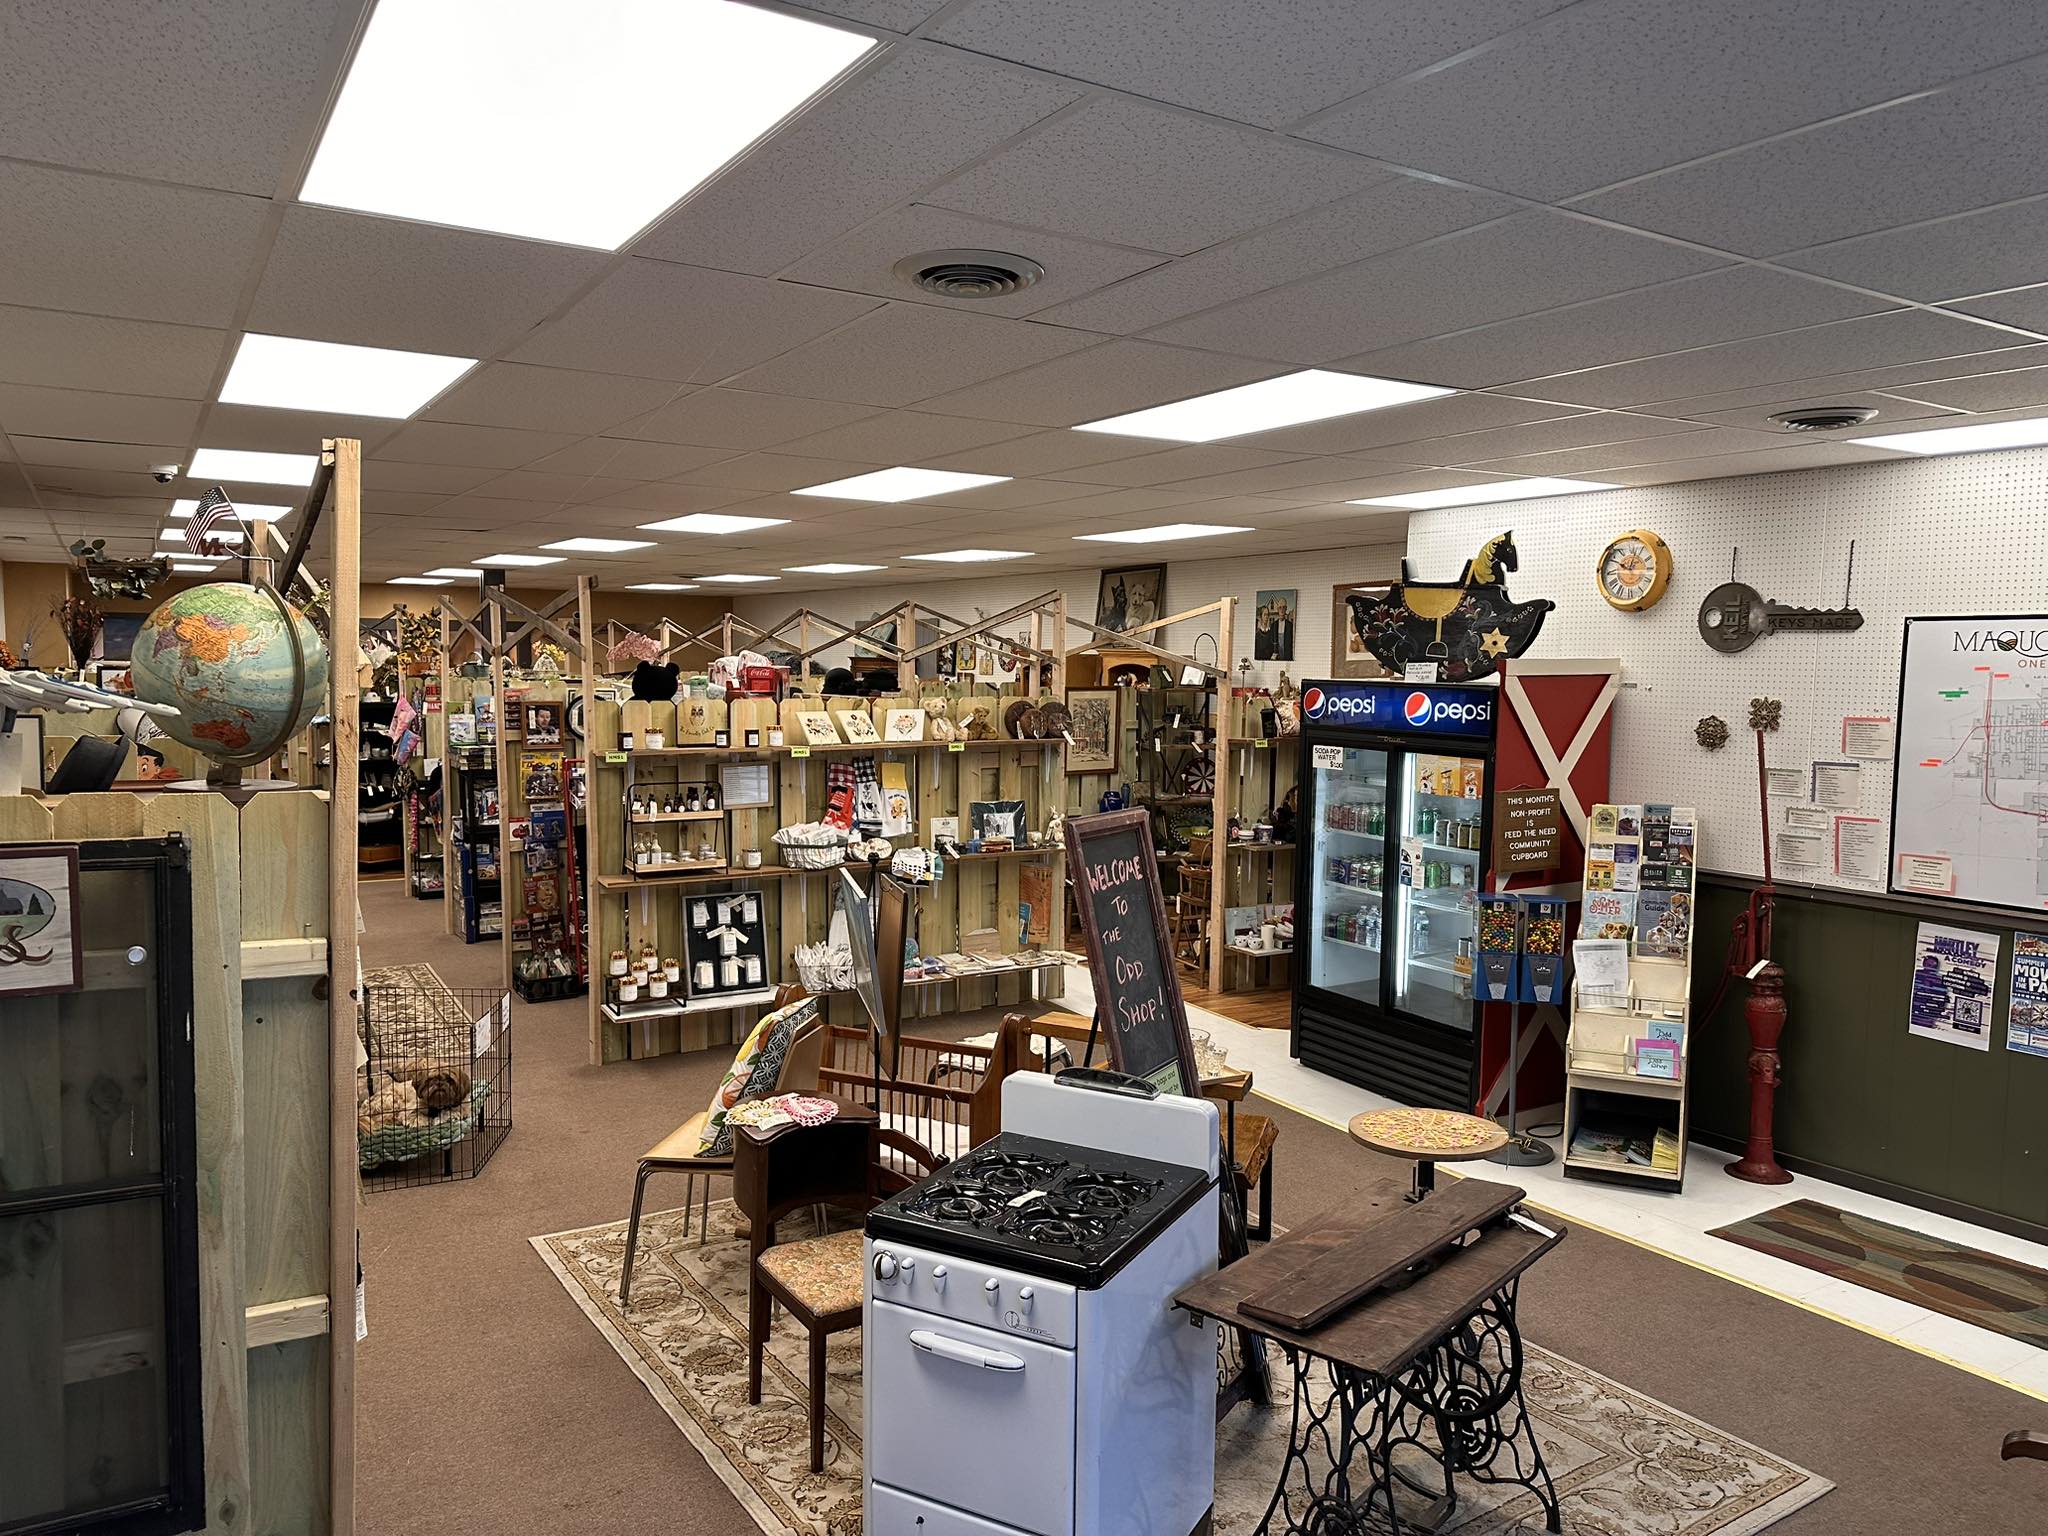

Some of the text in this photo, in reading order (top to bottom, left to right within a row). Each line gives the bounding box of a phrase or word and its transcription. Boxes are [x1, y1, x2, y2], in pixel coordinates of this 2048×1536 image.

[1723, 594, 1742, 641] KEIL
[1768, 617, 1853, 628] KEYS MADE
[2018, 659, 2047, 669] ONE
[1328, 695, 1376, 717] pepsi
[1434, 701, 1491, 724] pepsi
[1314, 747, 1342, 756] SODA POP
[1507, 795, 1555, 805] THIS MONTH'S
[1526, 819, 1534, 827] IS
[1504, 827, 1557, 839] FEED THE NEED
[1509, 840, 1551, 850] COMMUNITY
[1511, 851, 1549, 861] CUPBOARD
[1085, 855, 1144, 895] WELCOME
[1101, 926, 1122, 945] THE
[1951, 956, 1987, 969] COMEDY
[2016, 957, 2046, 967] SUMMER
[1115, 955, 1144, 985] ODD
[2015, 981, 2027, 990] THE
